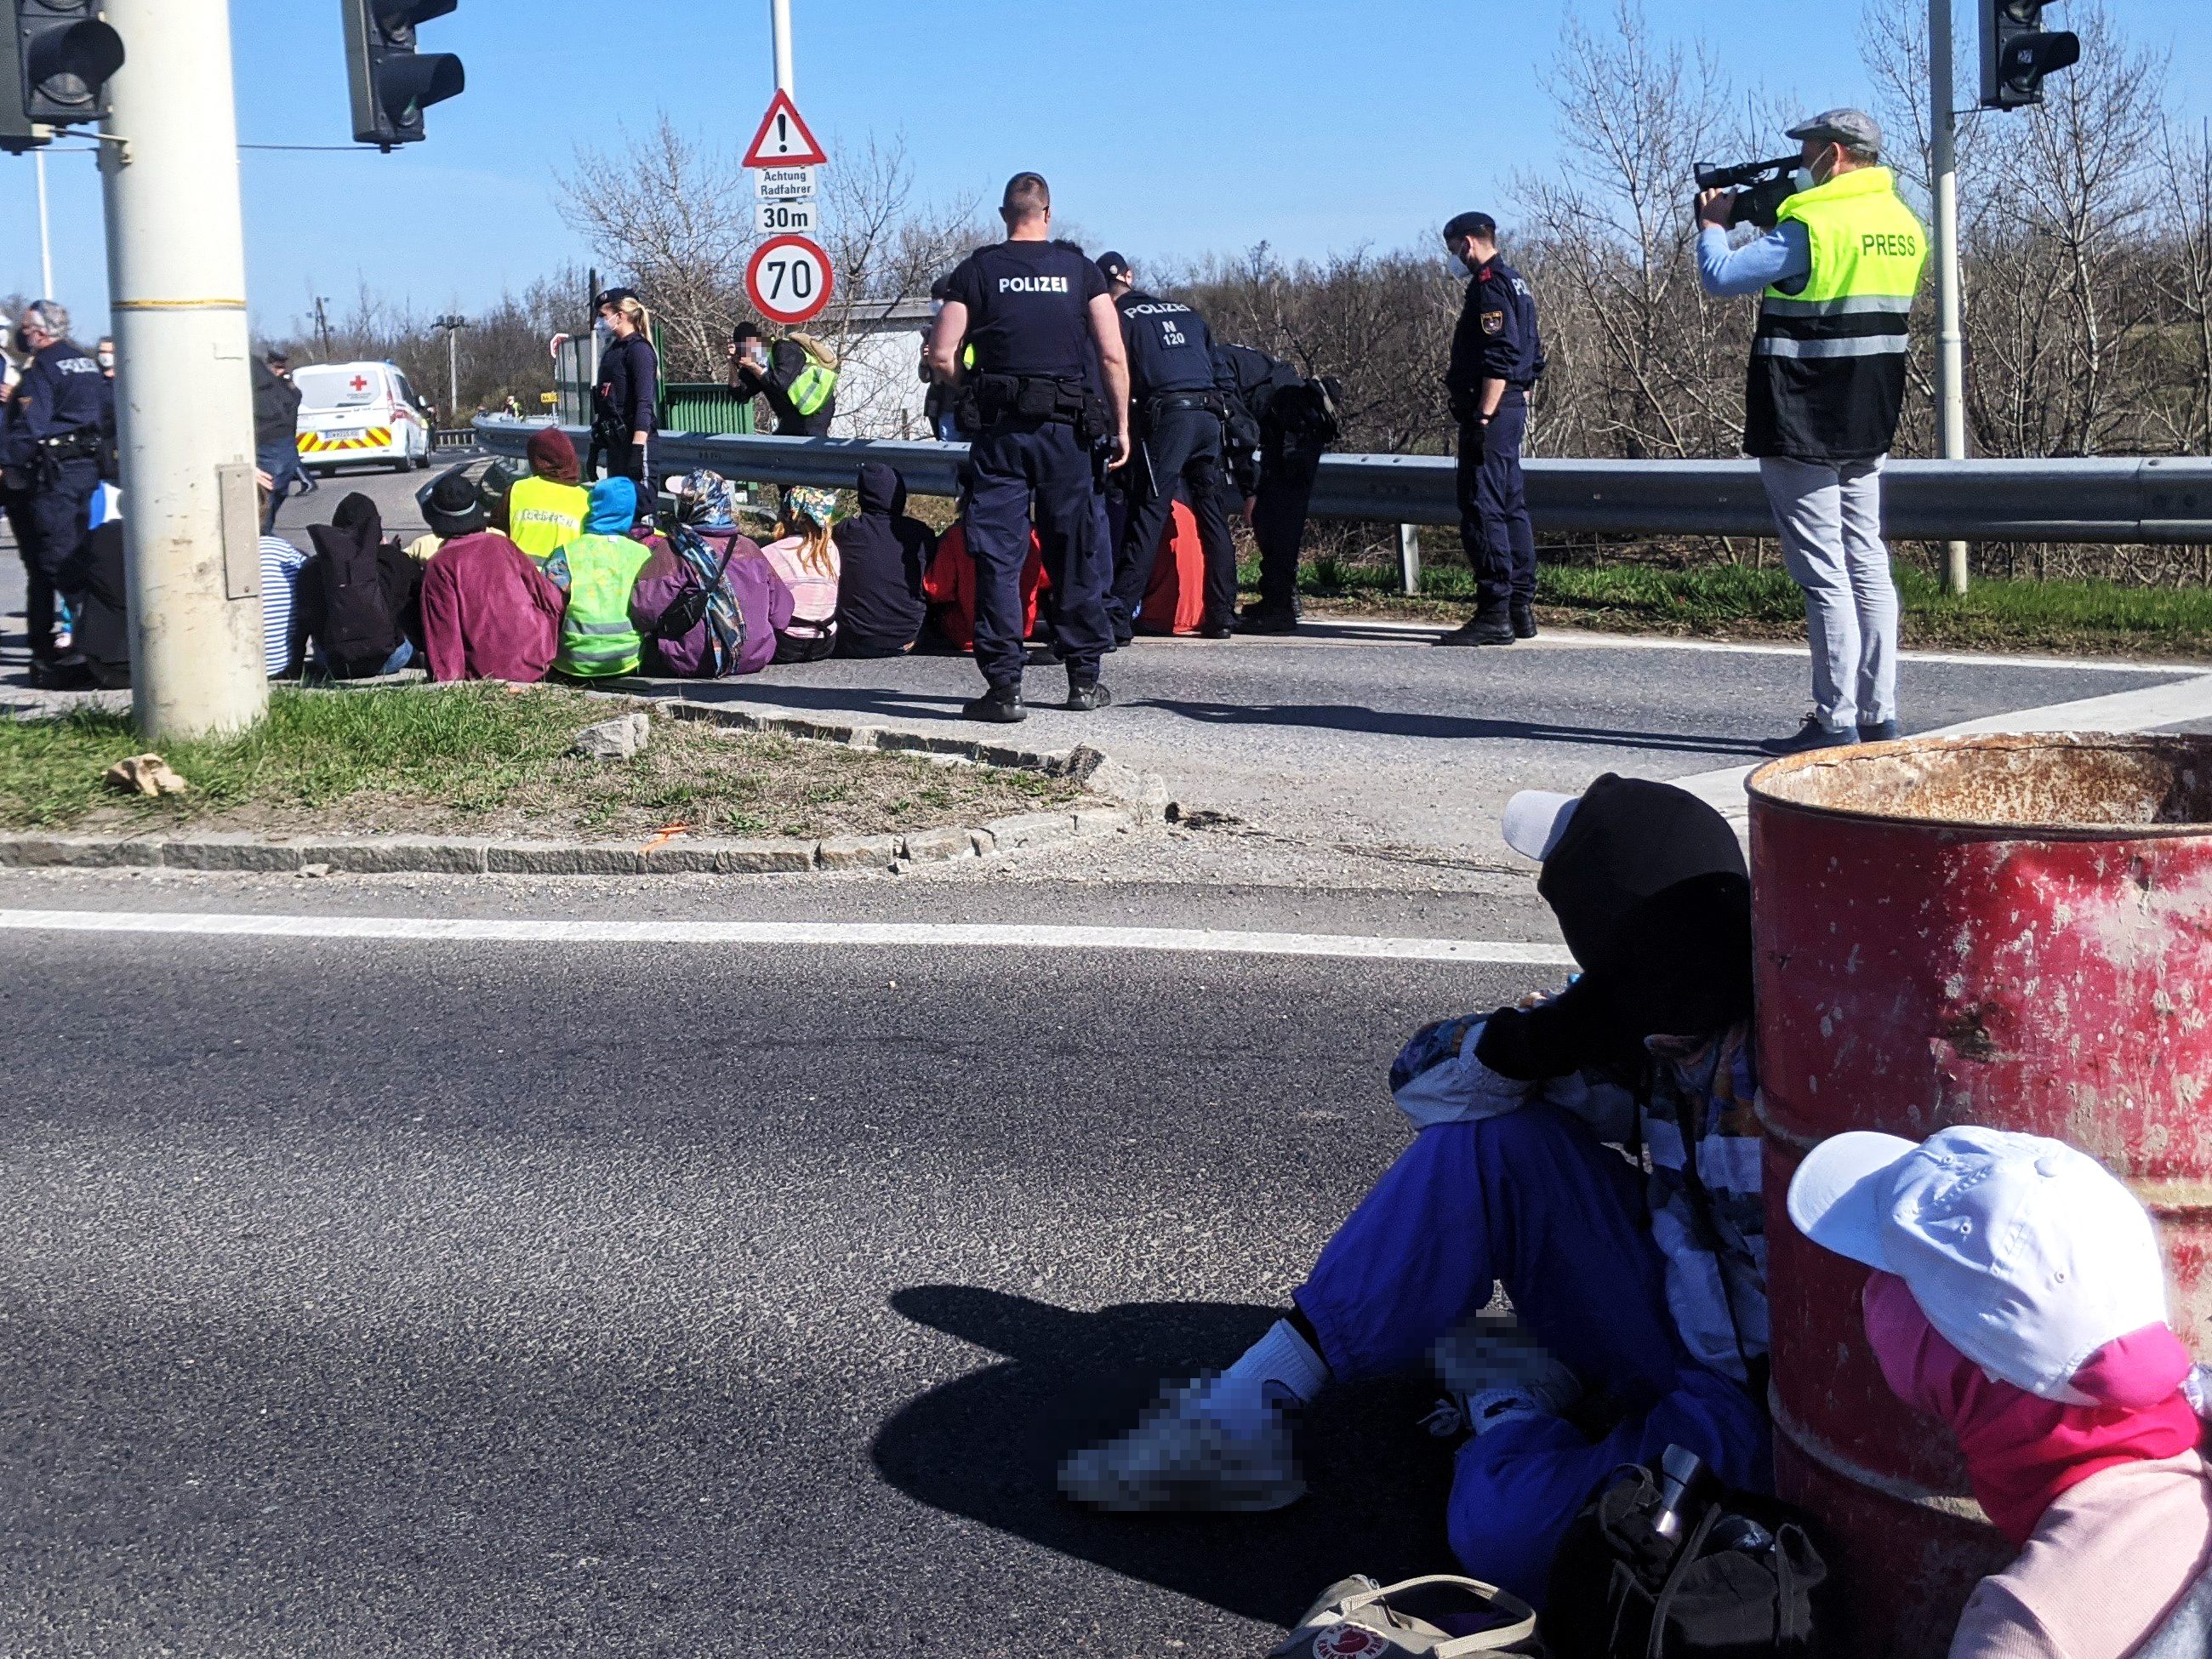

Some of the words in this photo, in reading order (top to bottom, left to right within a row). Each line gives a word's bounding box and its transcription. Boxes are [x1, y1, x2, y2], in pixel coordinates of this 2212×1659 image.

[764, 171, 807, 182] Achtung
[761, 184, 811, 196] Radfahrer
[1861, 234, 1916, 257] PRESS
[767, 259, 811, 299] 70
[999, 276, 1069, 293] POLIZEI
[1123, 303, 1191, 319] POLIZEI
[1162, 320, 1177, 333] N
[1163, 333, 1185, 345] 120
